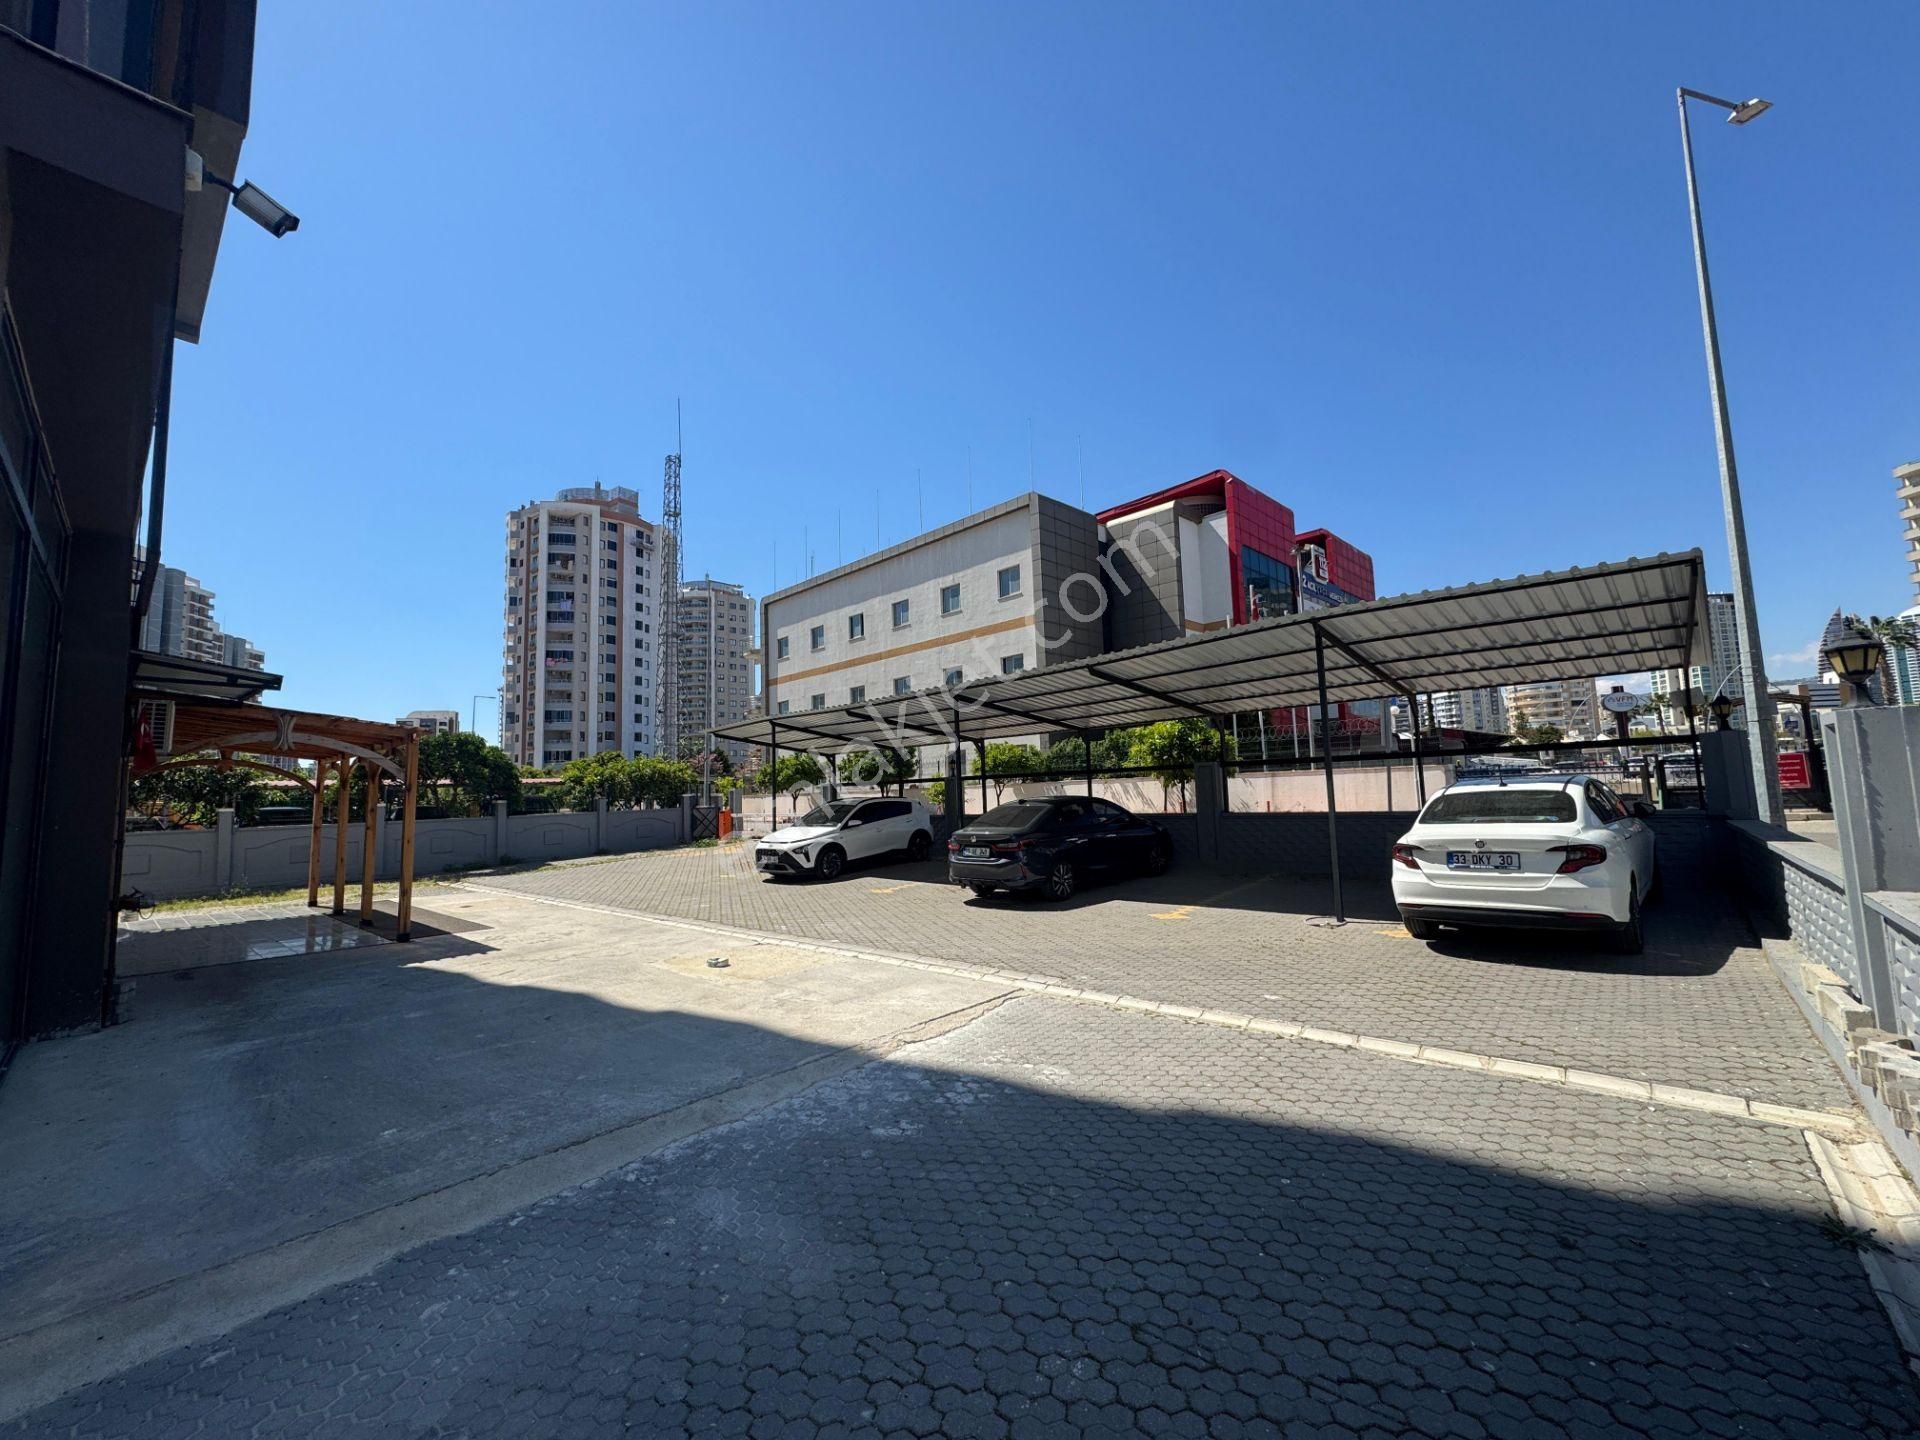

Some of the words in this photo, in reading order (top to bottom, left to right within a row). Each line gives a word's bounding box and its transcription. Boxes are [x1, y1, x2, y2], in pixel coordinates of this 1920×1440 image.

[1454, 854, 1467, 865] 33
[1472, 854, 1491, 865] DKY
[1499, 855, 1513, 866] 30
